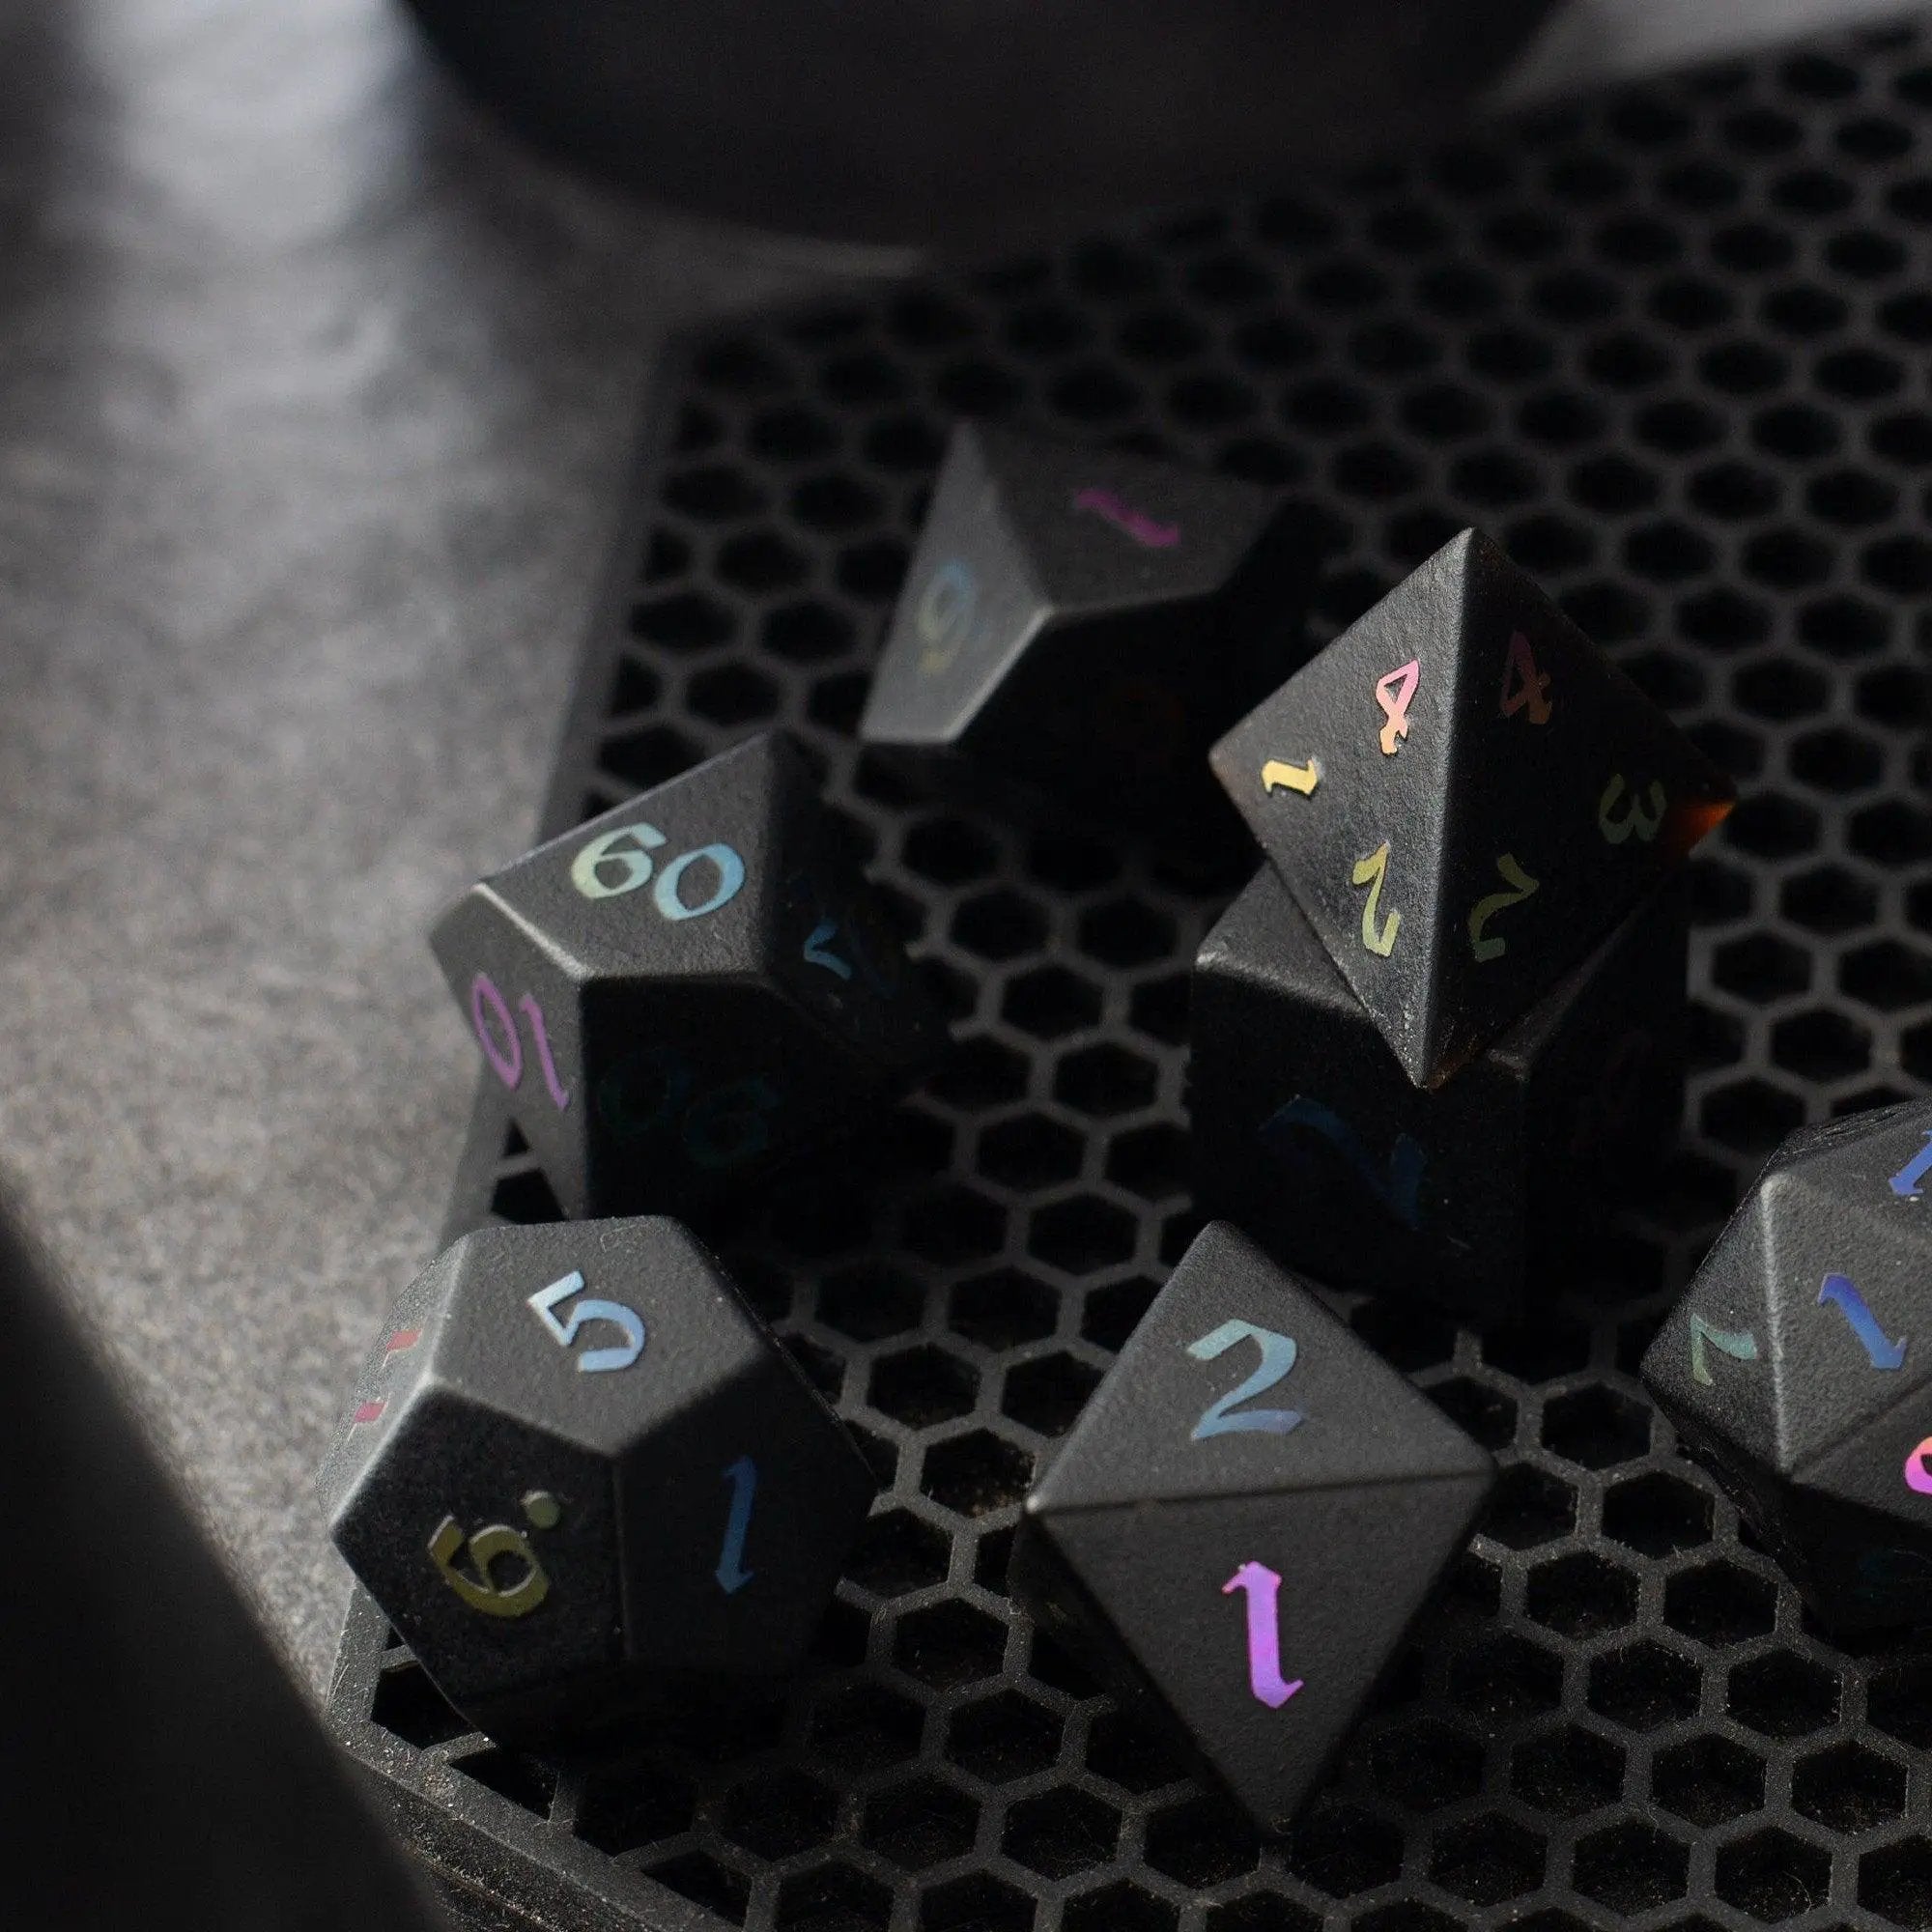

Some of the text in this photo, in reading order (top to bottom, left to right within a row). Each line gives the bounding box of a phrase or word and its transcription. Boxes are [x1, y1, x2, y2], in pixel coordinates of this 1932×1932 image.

[1074, 487, 1181, 549] 1
[1375, 659, 1421, 756] 4
[1261, 755, 1320, 798] 1
[1597, 773, 1667, 846] 3
[570, 822, 747, 921] 60
[1351, 842, 1401, 958] 2
[1465, 852, 1541, 963] 2
[527, 1270, 646, 1374] 5
[1187, 1318, 1304, 1440] 2
[715, 1455, 758, 1597] 1
[1222, 1560, 1305, 1710] 1
